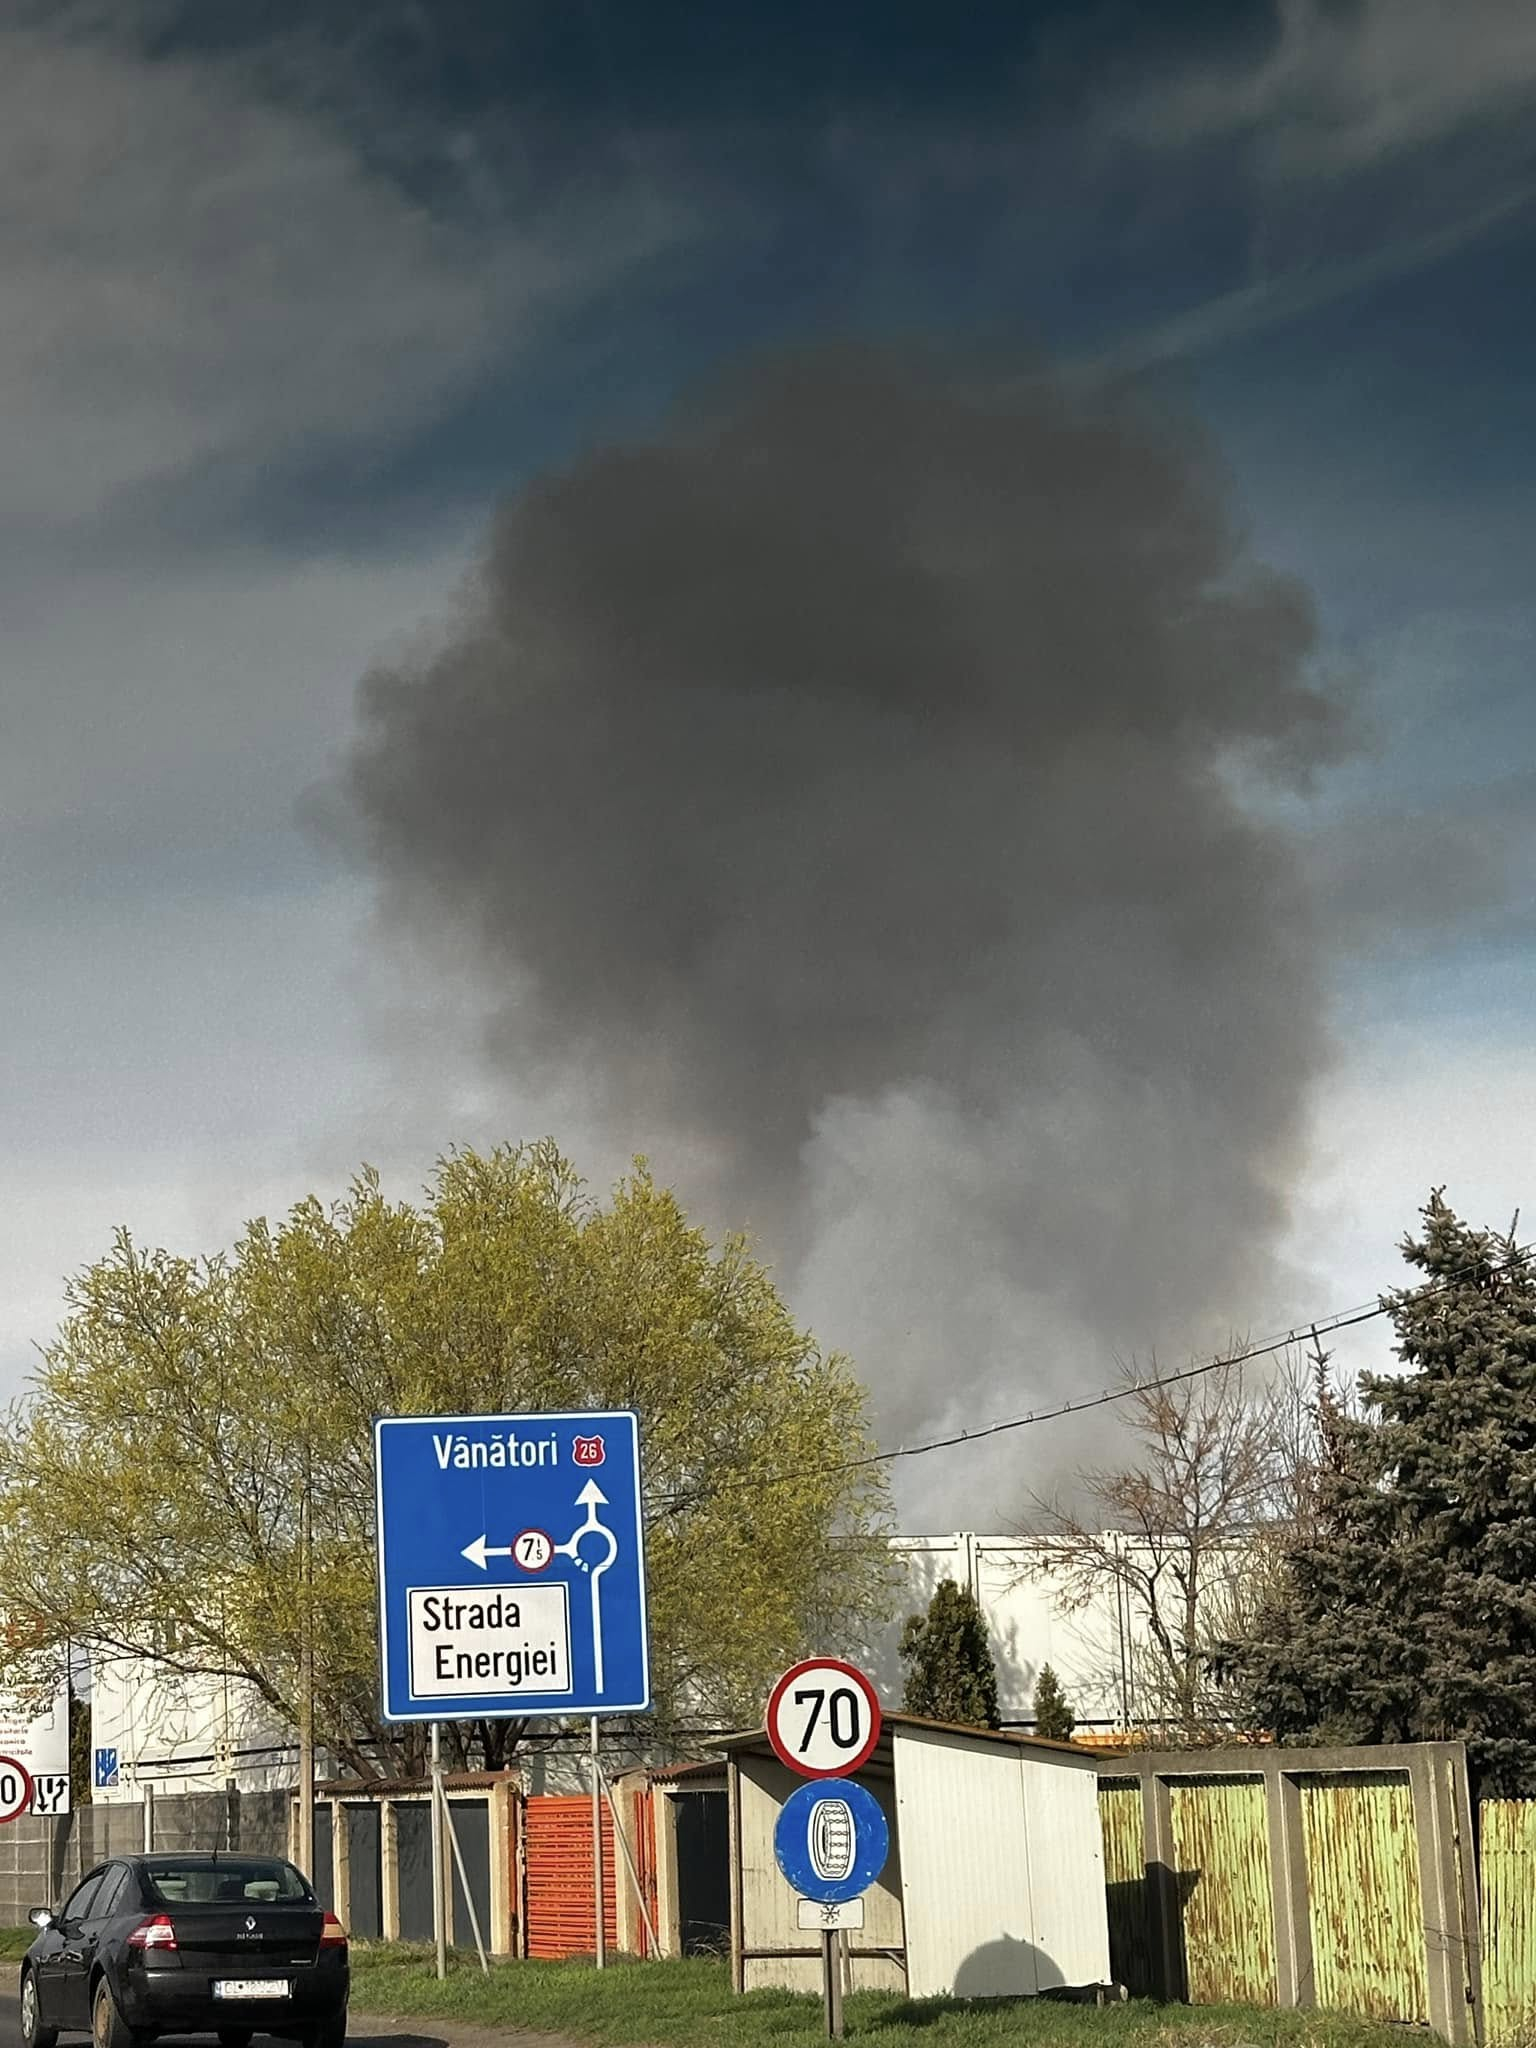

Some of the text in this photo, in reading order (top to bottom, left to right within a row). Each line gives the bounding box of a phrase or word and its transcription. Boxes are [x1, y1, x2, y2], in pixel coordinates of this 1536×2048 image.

[433, 1432, 598, 1470] Vânători 26
[423, 1594, 521, 1632] Strada
[435, 1641, 557, 1686] Energiei
[795, 1688, 860, 1753] 70
[0, 1774, 17, 1805] 0
